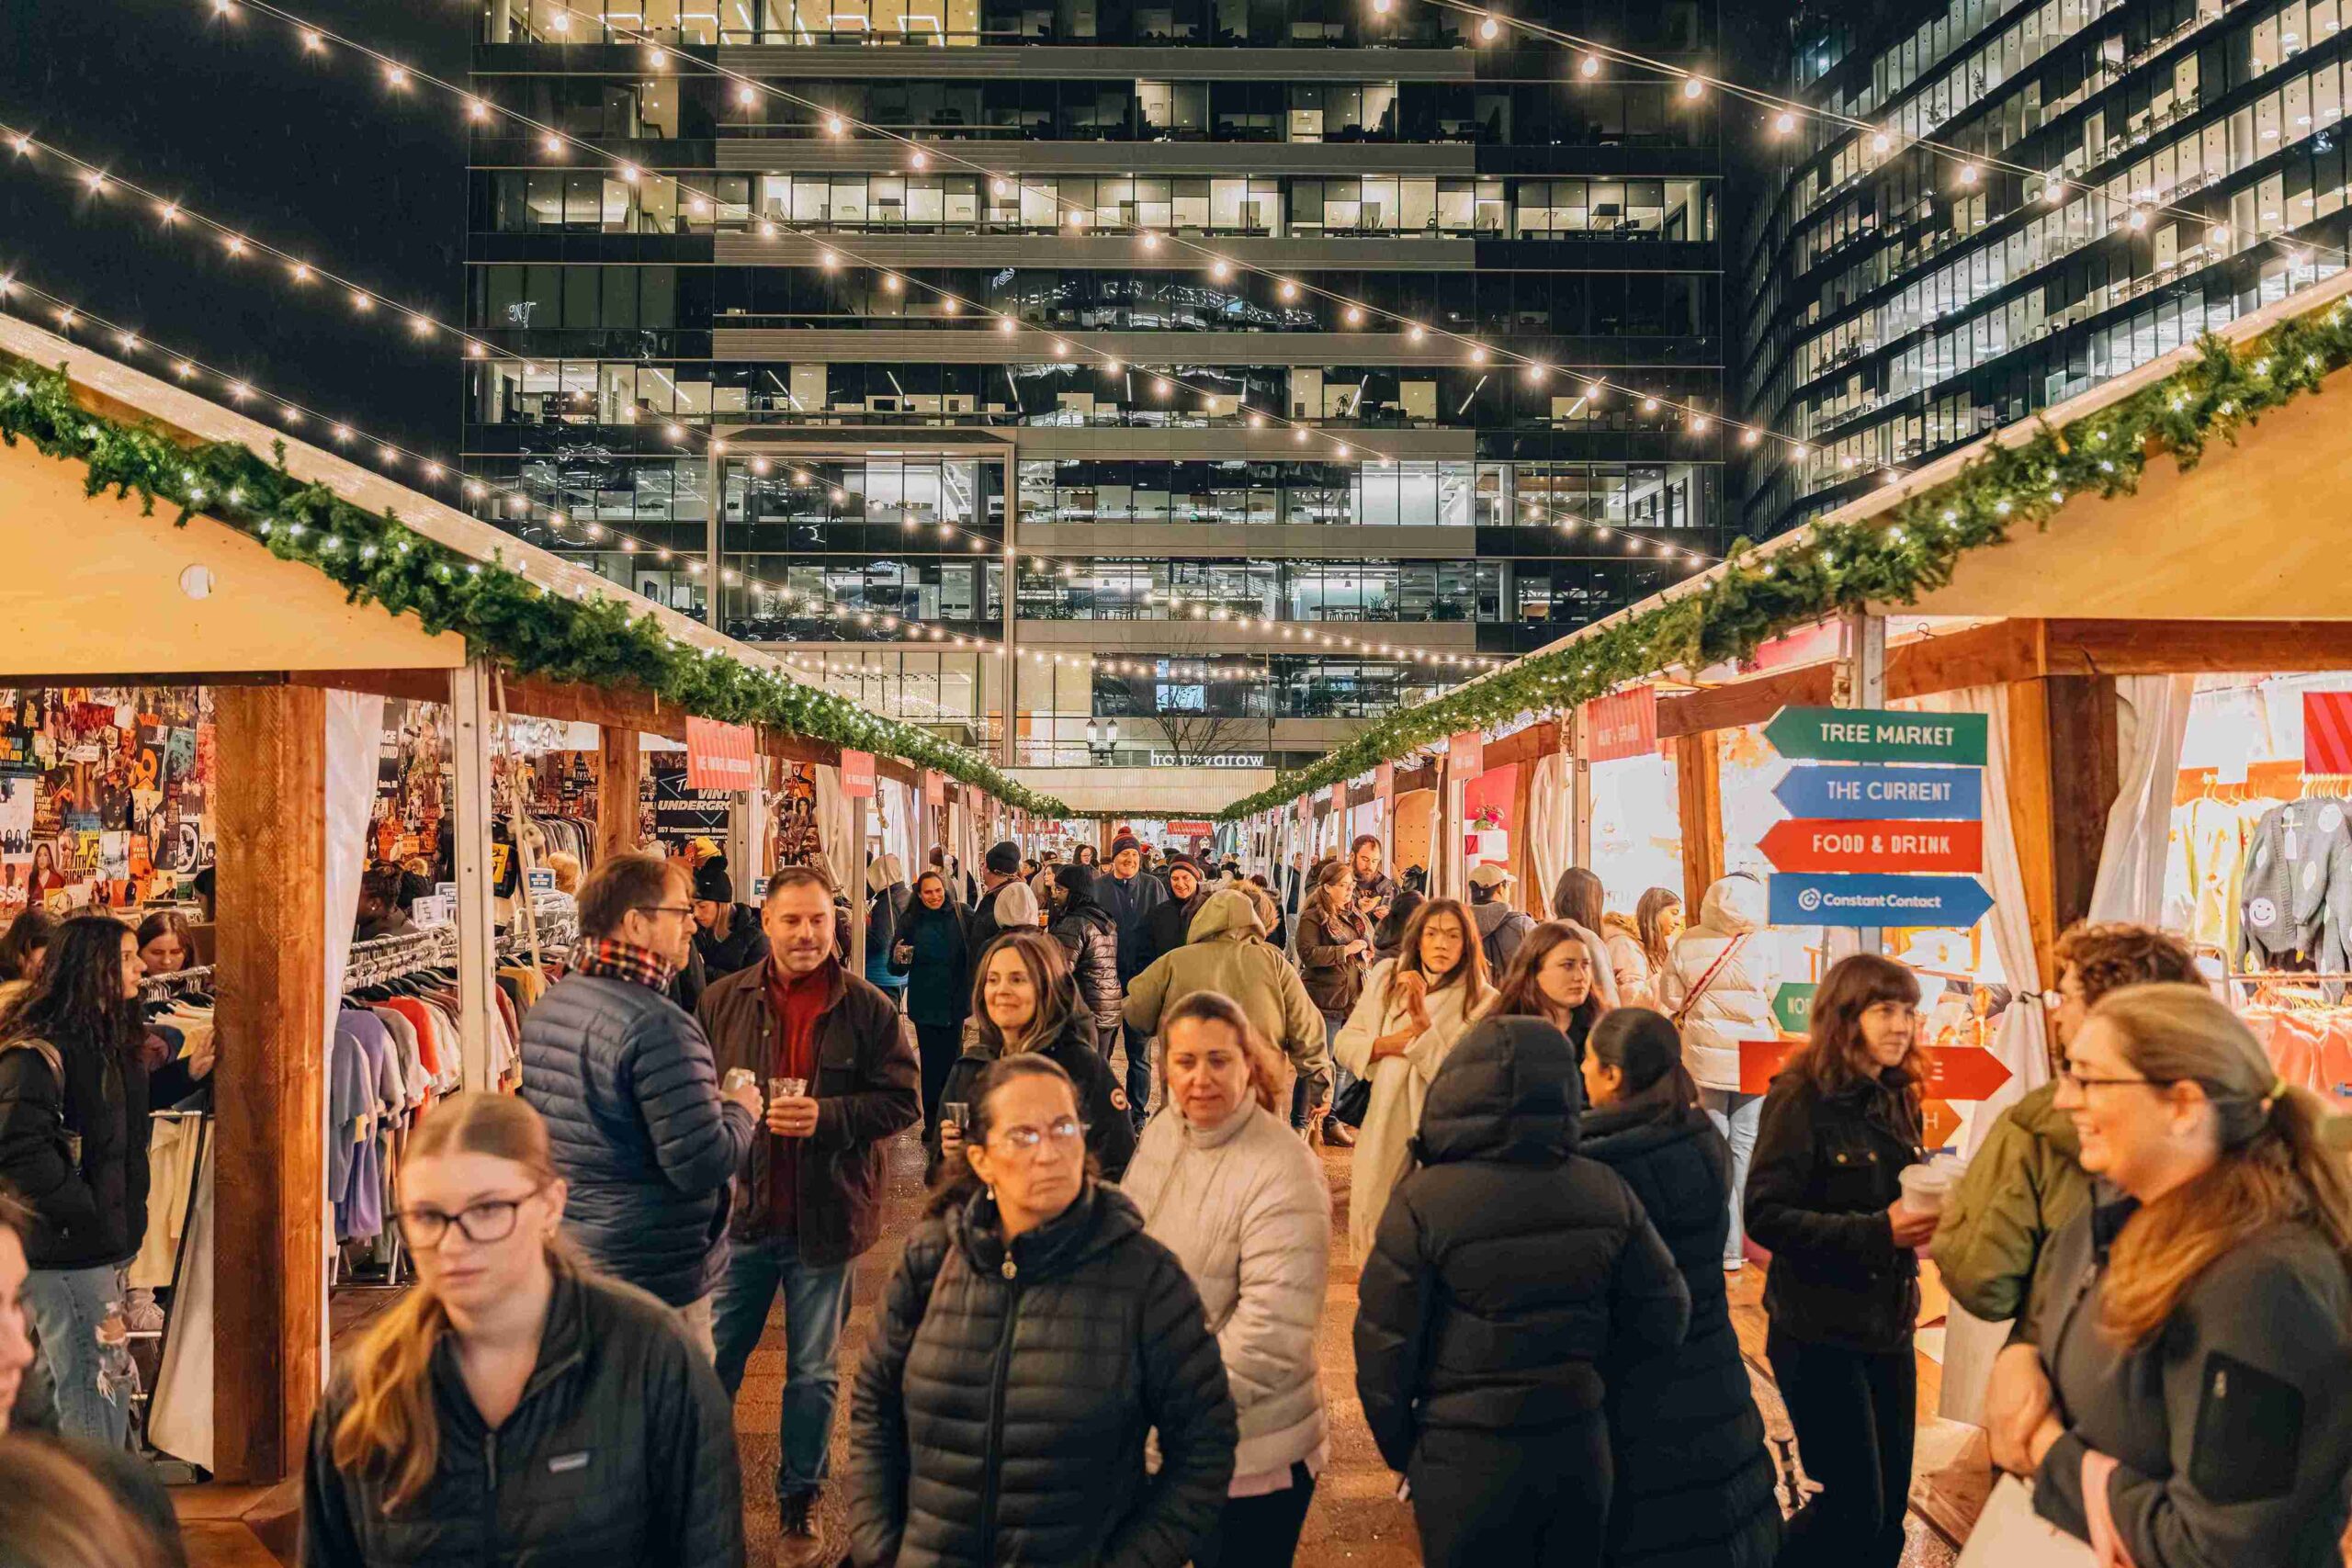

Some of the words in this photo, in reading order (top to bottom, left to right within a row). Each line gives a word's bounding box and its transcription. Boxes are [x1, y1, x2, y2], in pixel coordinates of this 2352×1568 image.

[1820, 723, 1870, 743] TREE
[1876, 725, 1954, 746] MARKET
[698, 789, 731, 800] VINT
[1826, 781, 1861, 800] THE
[1867, 782, 1951, 801] CURRENT
[658, 800, 731, 810] UNDERGRO
[1813, 834, 1864, 852] FOOD
[1871, 835, 1883, 853] &
[1891, 834, 1951, 854] DRINK
[1823, 893, 1885, 907] Constant
[1886, 894, 1941, 908] Contact
